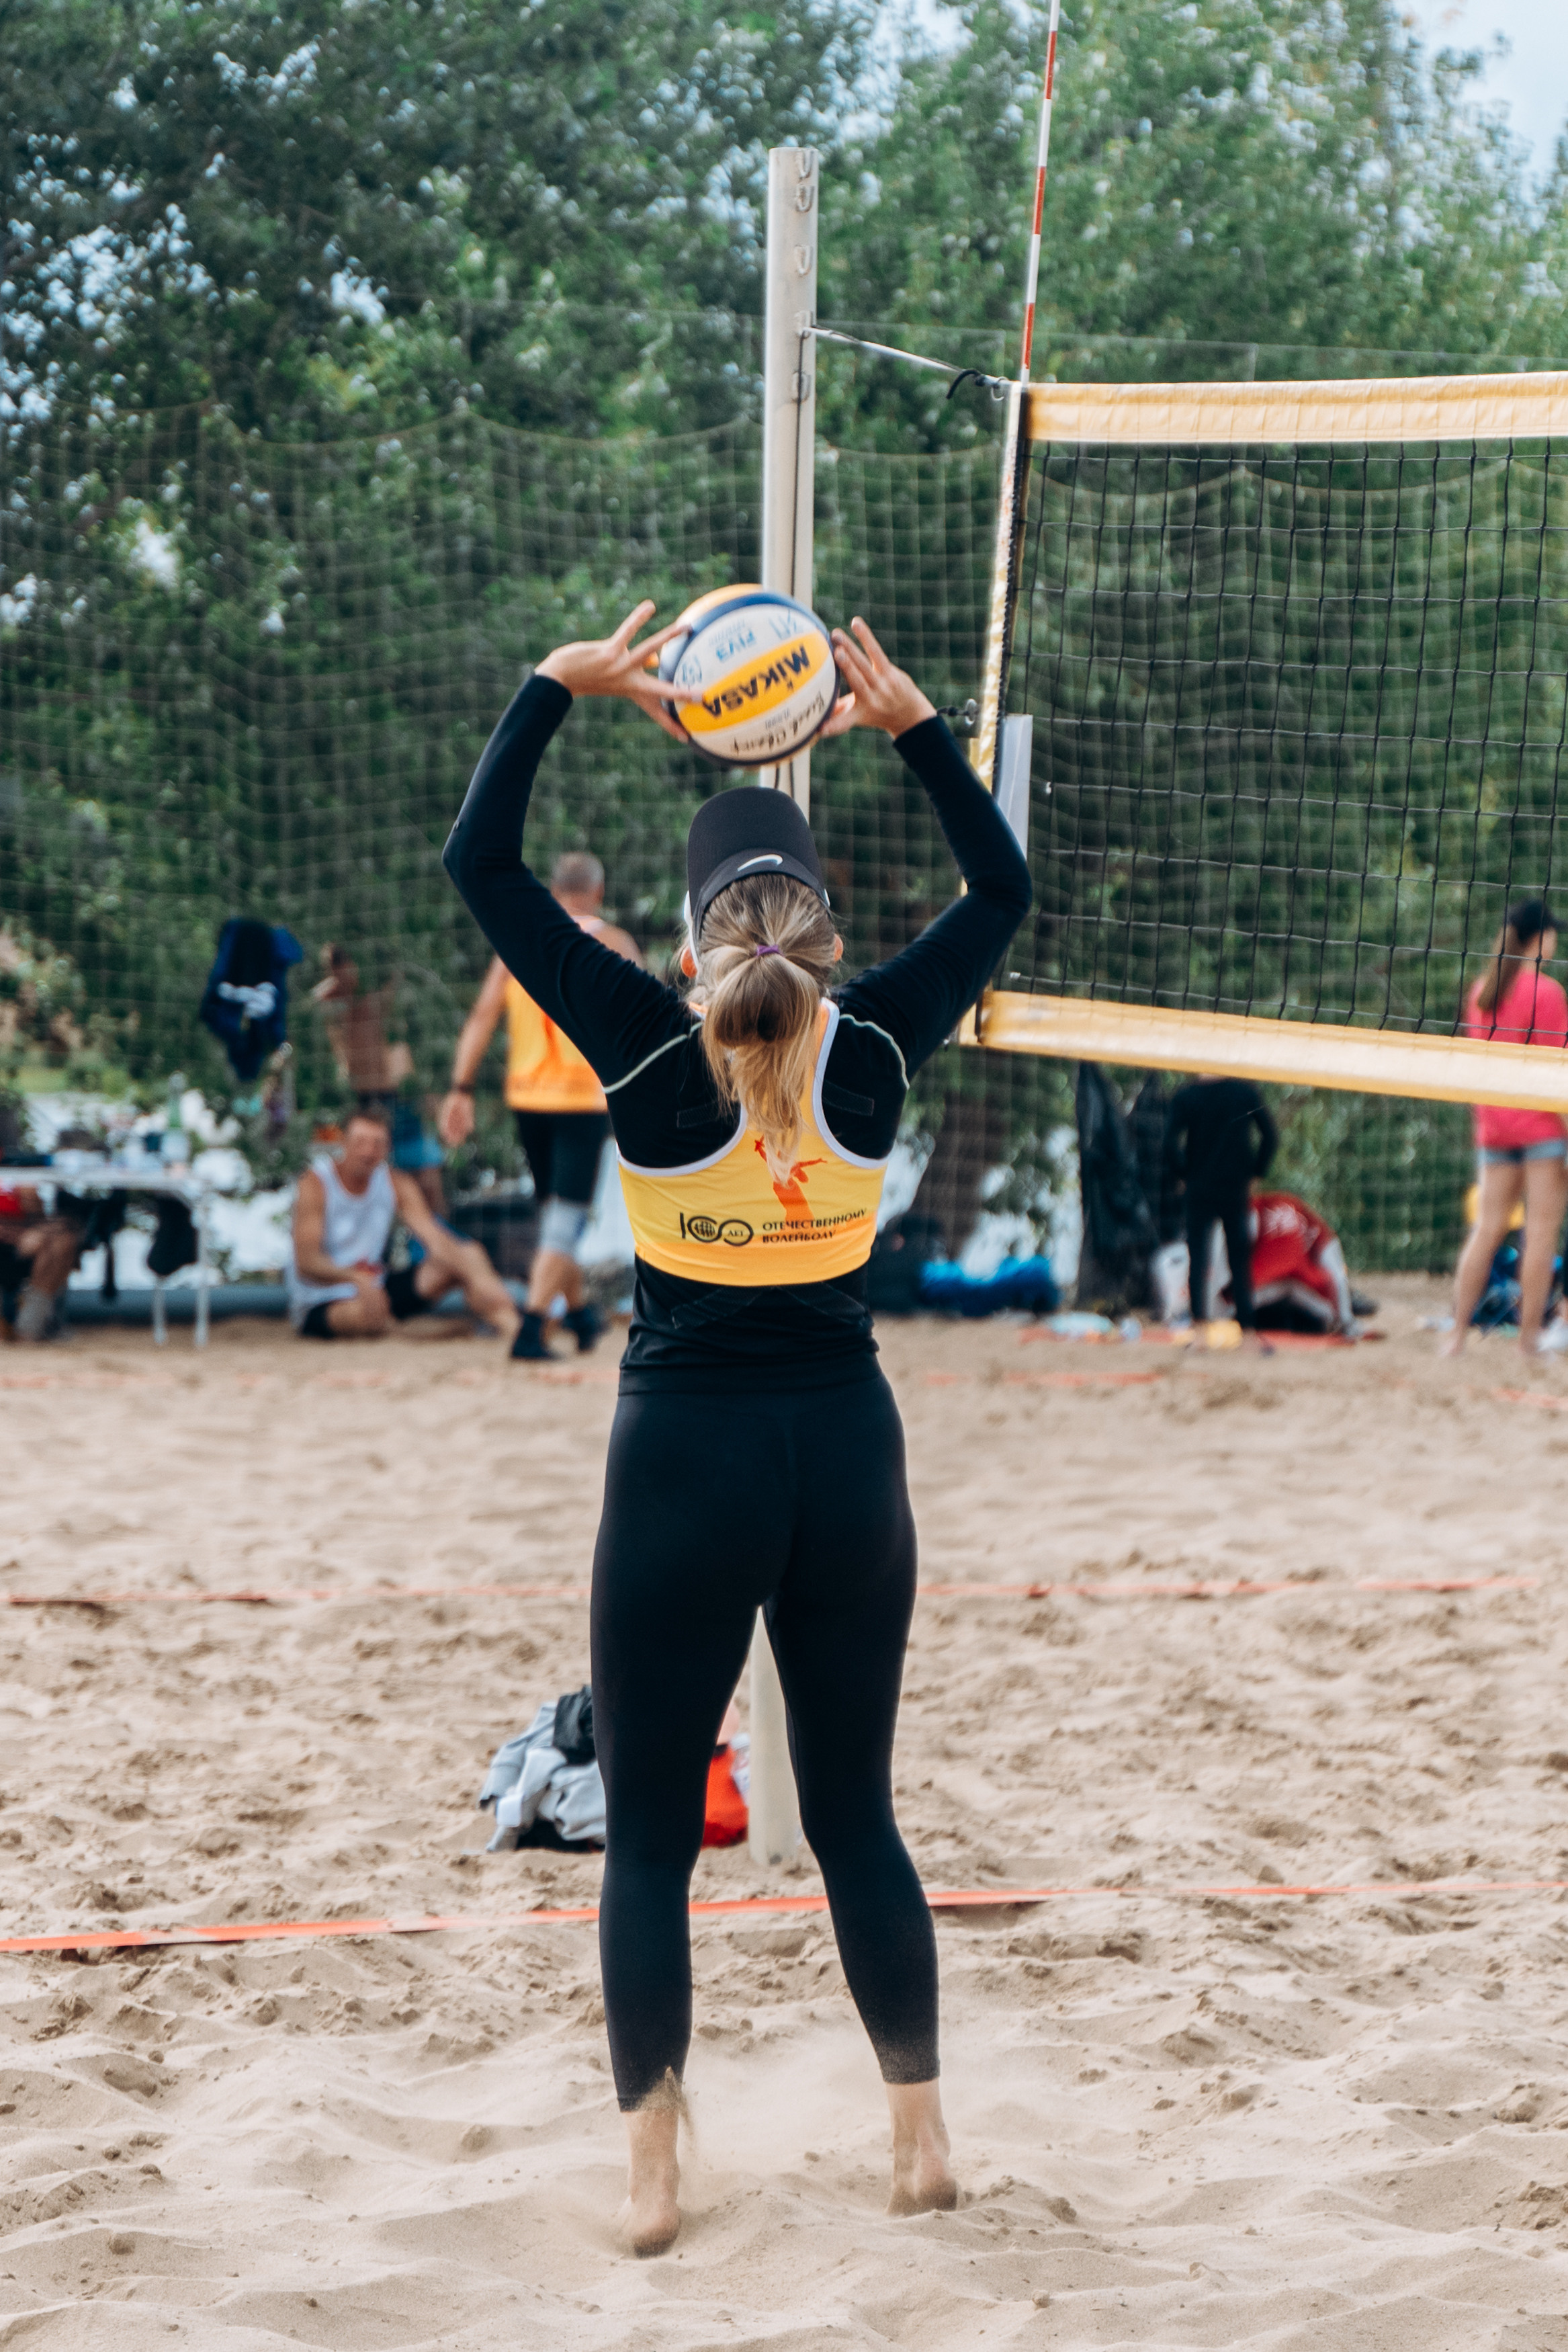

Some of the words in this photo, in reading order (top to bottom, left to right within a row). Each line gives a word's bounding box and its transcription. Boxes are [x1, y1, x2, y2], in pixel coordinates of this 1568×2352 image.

[703, 645, 810, 718] MIKASA
[763, 1209, 867, 1231] ОТЕЧЕСТВЕННОМУ
[763, 1231, 836, 1244] ВОЛЕЙБОЛУ
